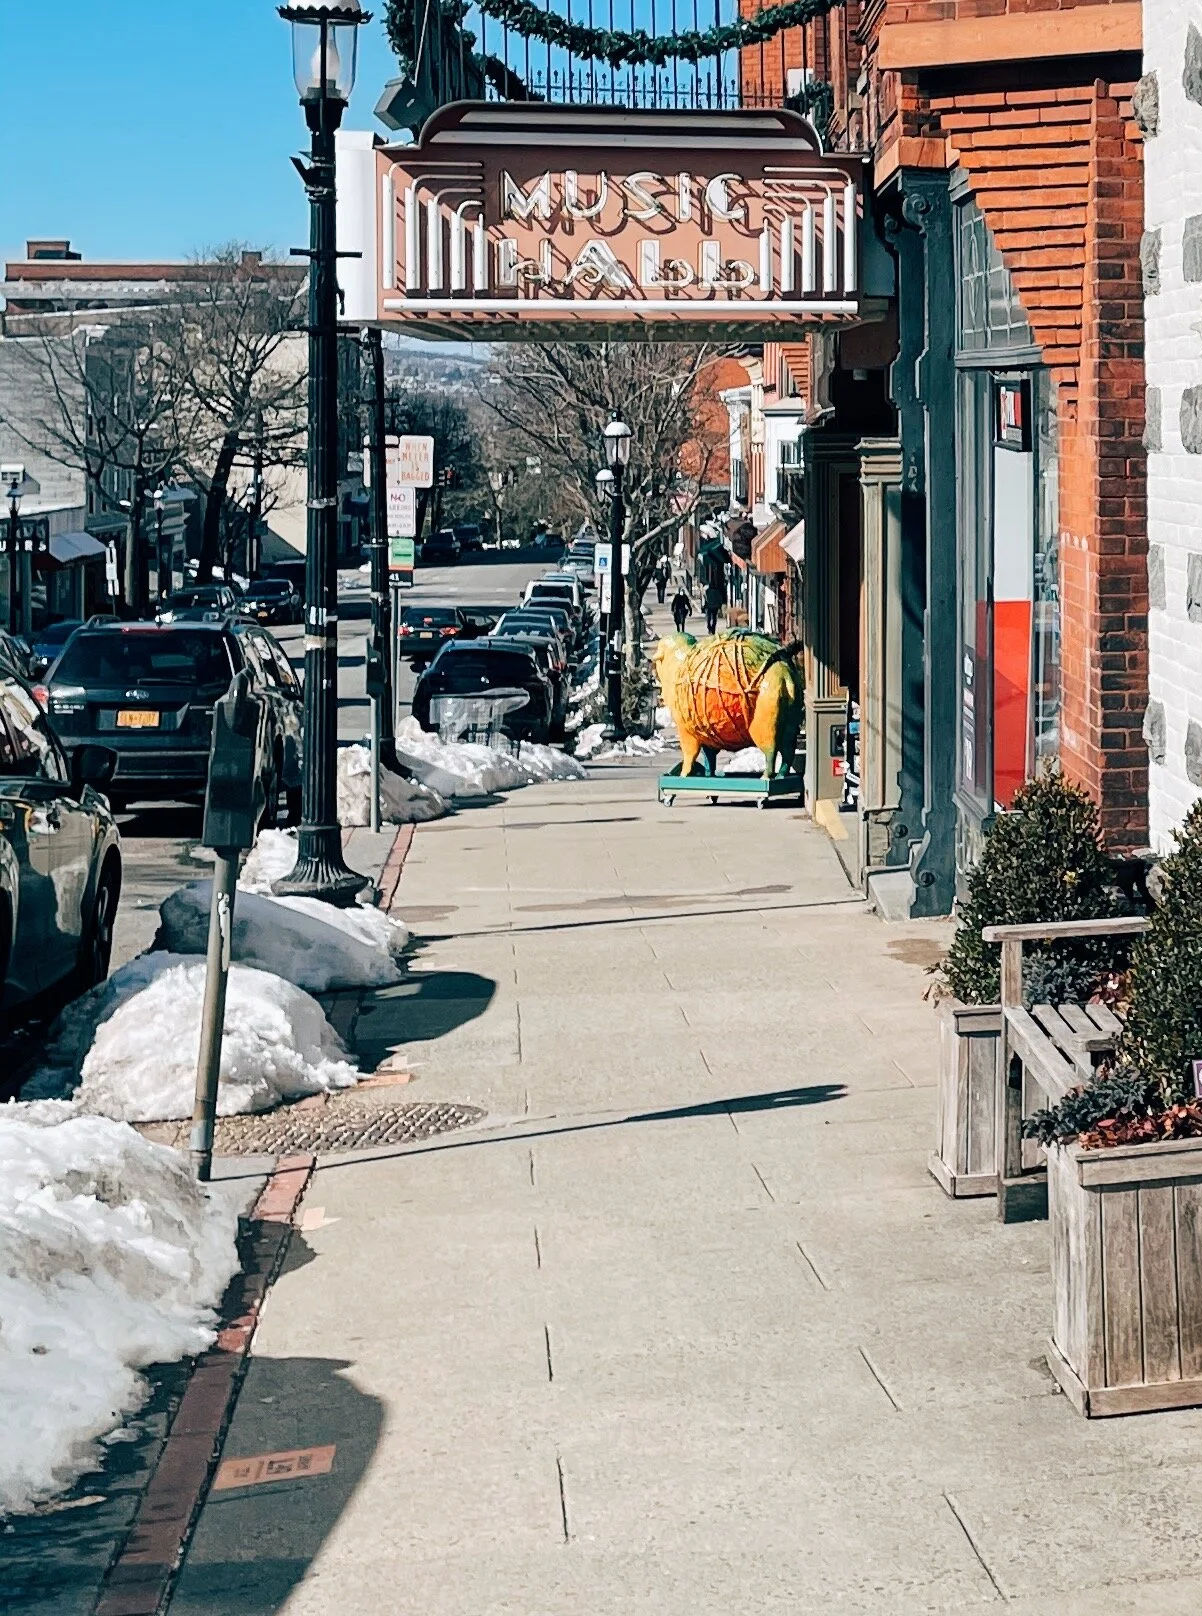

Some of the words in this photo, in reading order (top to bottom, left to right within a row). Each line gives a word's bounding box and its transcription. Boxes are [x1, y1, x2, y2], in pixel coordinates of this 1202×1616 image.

[498, 169, 748, 223] MUSIC
[497, 237, 755, 291] HALL
[390, 493, 406, 503] NO
